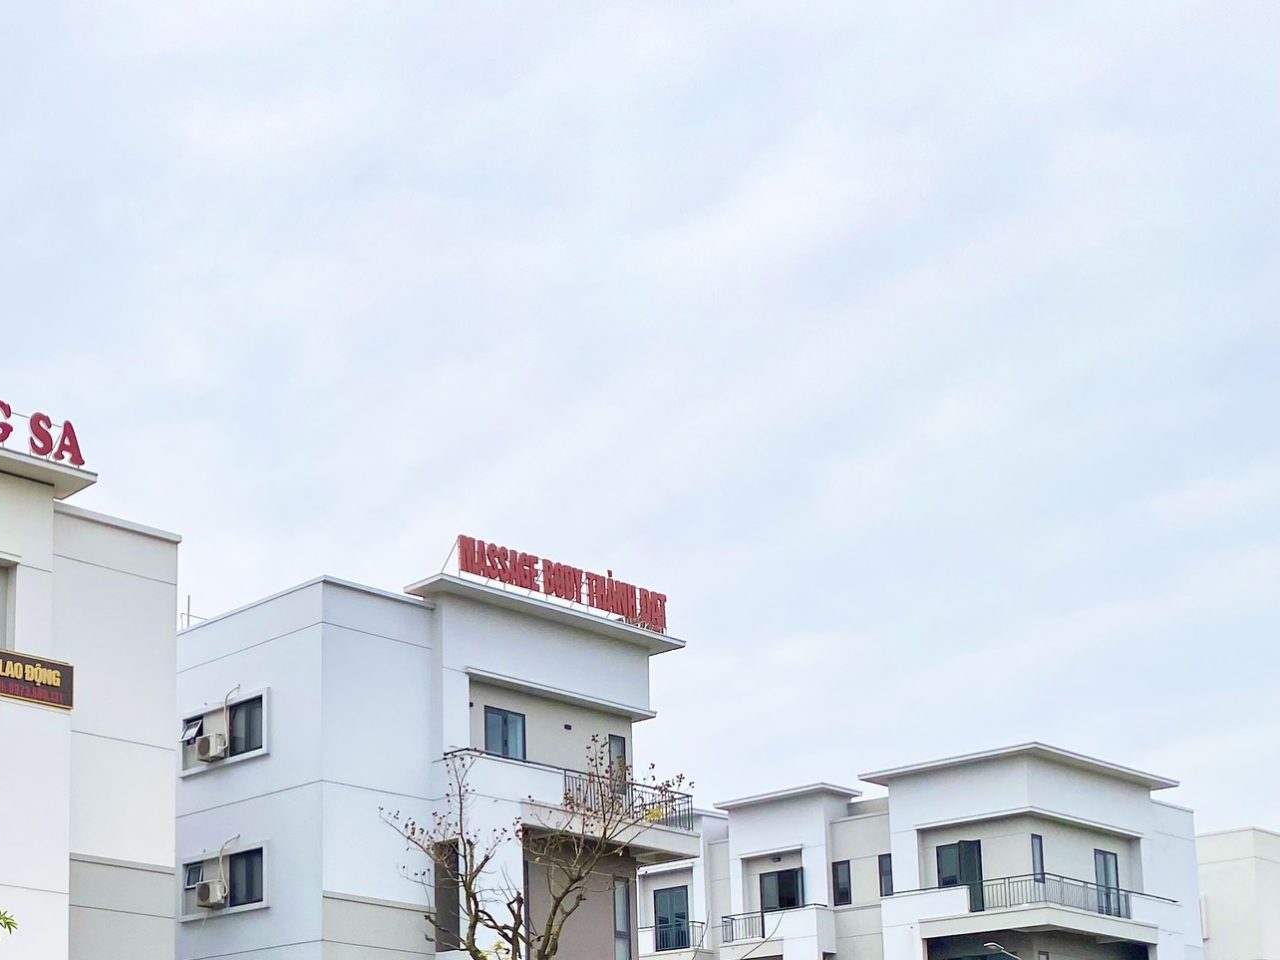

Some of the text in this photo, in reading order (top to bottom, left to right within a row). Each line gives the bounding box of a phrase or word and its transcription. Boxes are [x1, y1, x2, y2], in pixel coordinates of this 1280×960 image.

[28, 412, 85, 466] SA
[458, 534, 540, 592] MASSAGE
[542, 559, 584, 604] BODY
[24, 663, 61, 688] ĐỘNG
